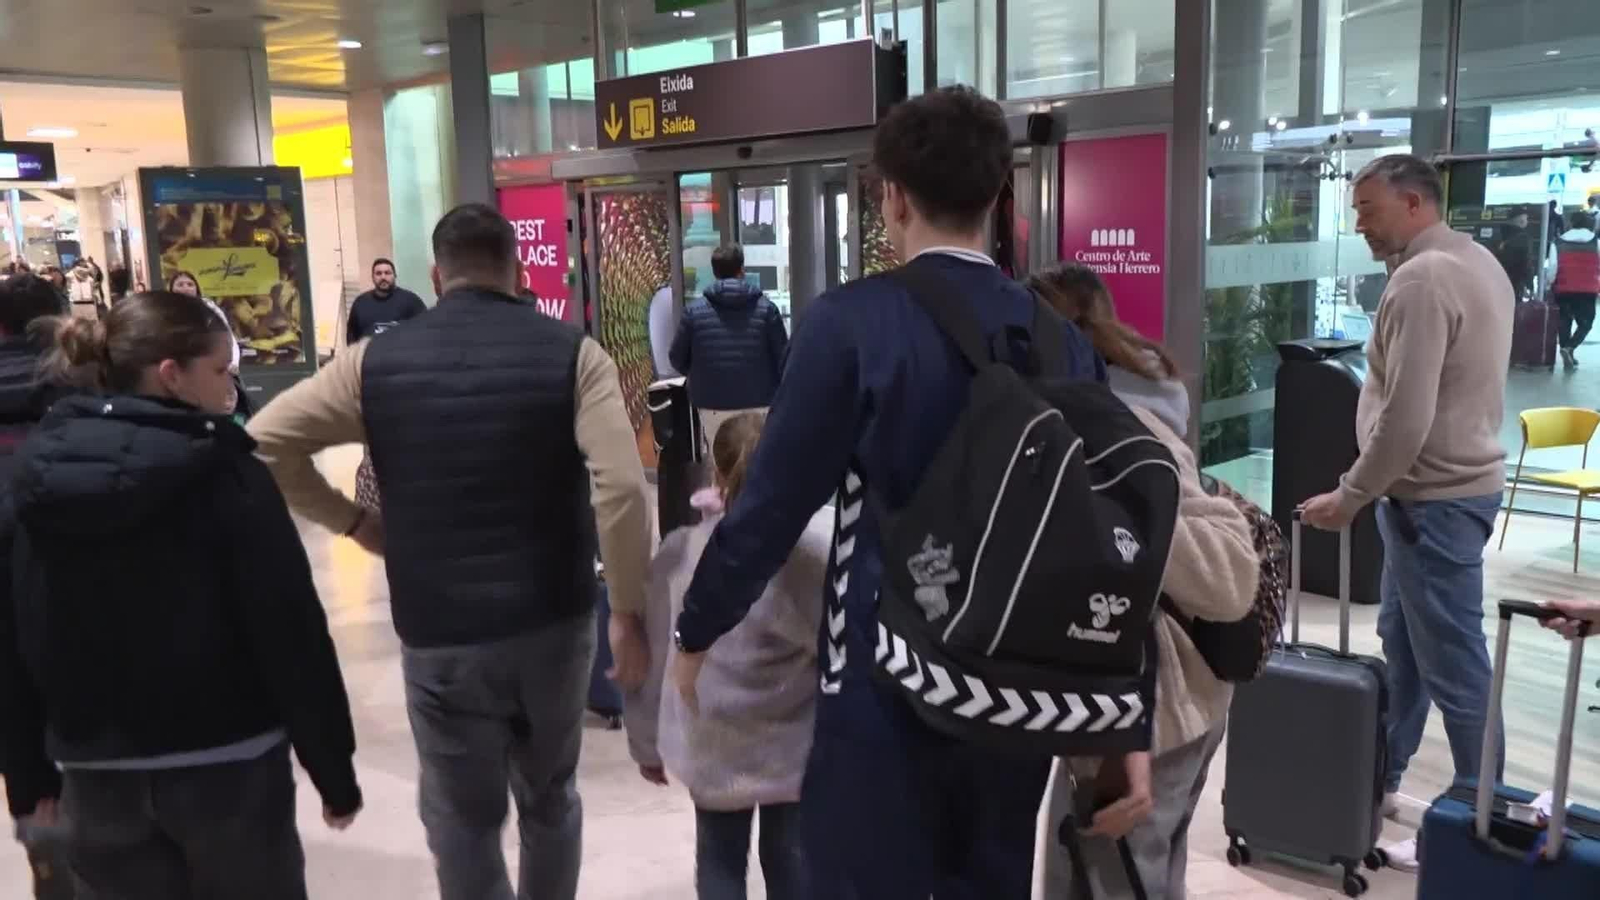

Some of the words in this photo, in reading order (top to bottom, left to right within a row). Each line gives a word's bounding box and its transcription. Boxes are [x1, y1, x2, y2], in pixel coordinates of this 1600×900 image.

[660, 74, 694, 94] Eixida
[661, 98, 677, 113] Exit
[662, 116, 696, 134] Salida
[517, 244, 558, 267] LACE
[1075, 249, 1111, 262] Centro
[1112, 249, 1126, 262] de
[1127, 249, 1151, 262] Arte
[1119, 262, 1160, 274] Herrero
